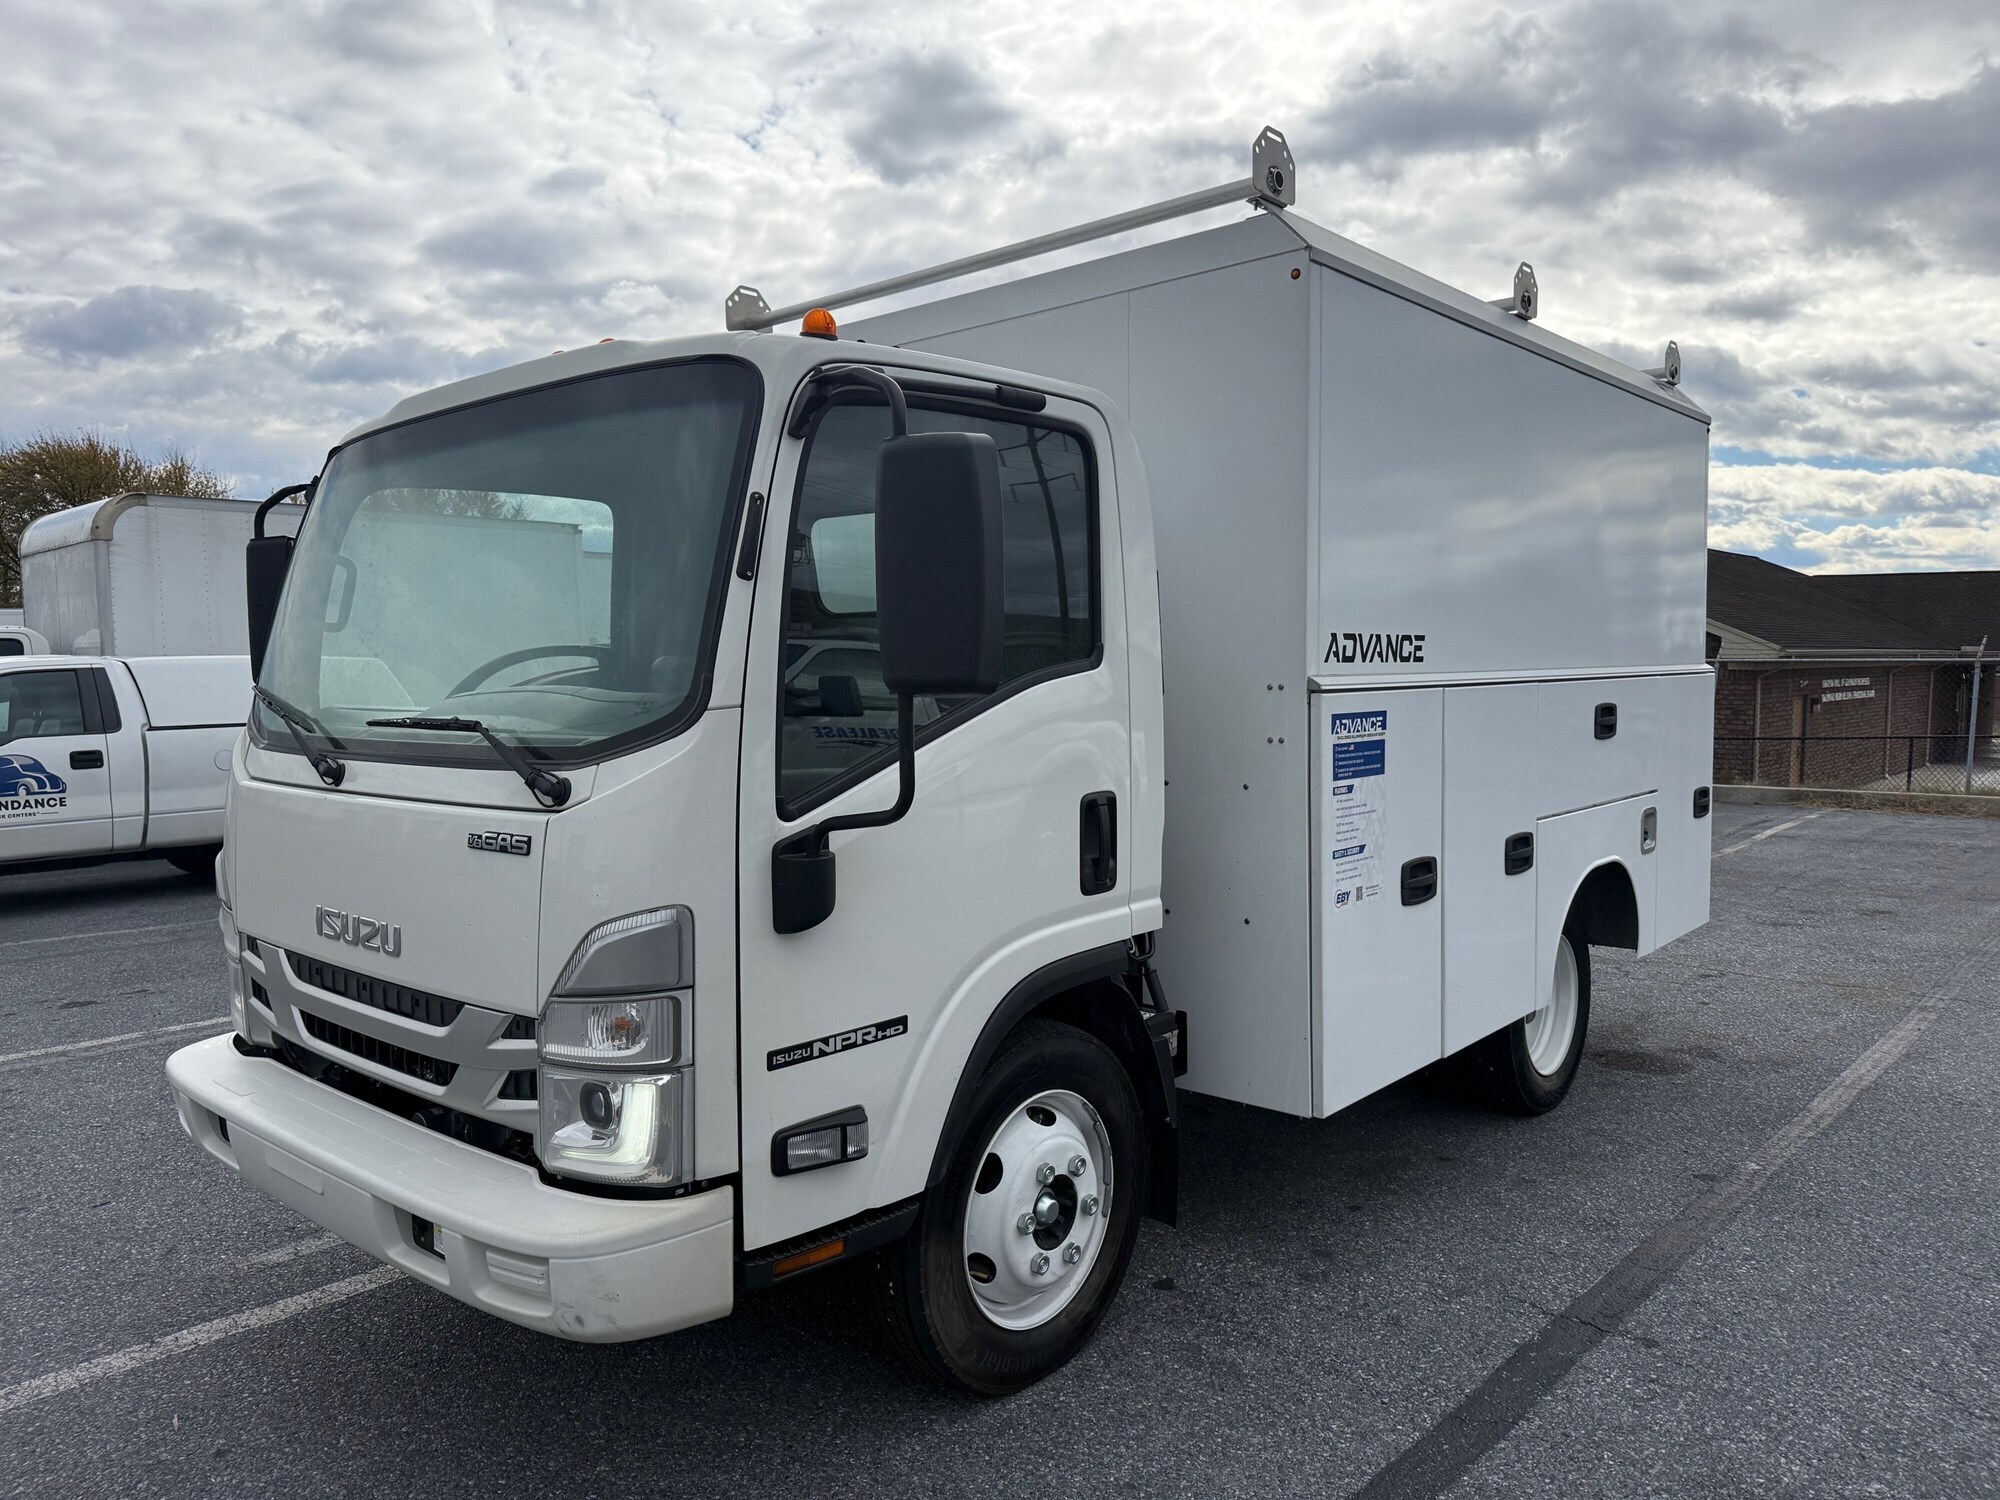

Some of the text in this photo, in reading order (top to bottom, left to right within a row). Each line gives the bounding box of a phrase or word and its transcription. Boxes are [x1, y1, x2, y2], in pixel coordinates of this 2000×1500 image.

[1324, 632, 1425, 663] ADVANCE
[1333, 716, 1383, 735] ADVANCE
[482, 832, 529, 854] GAS
[1336, 890, 1351, 904] EBY
[316, 904, 401, 958] ISUZU
[772, 1025, 904, 1066] ISUZU NPR HD
